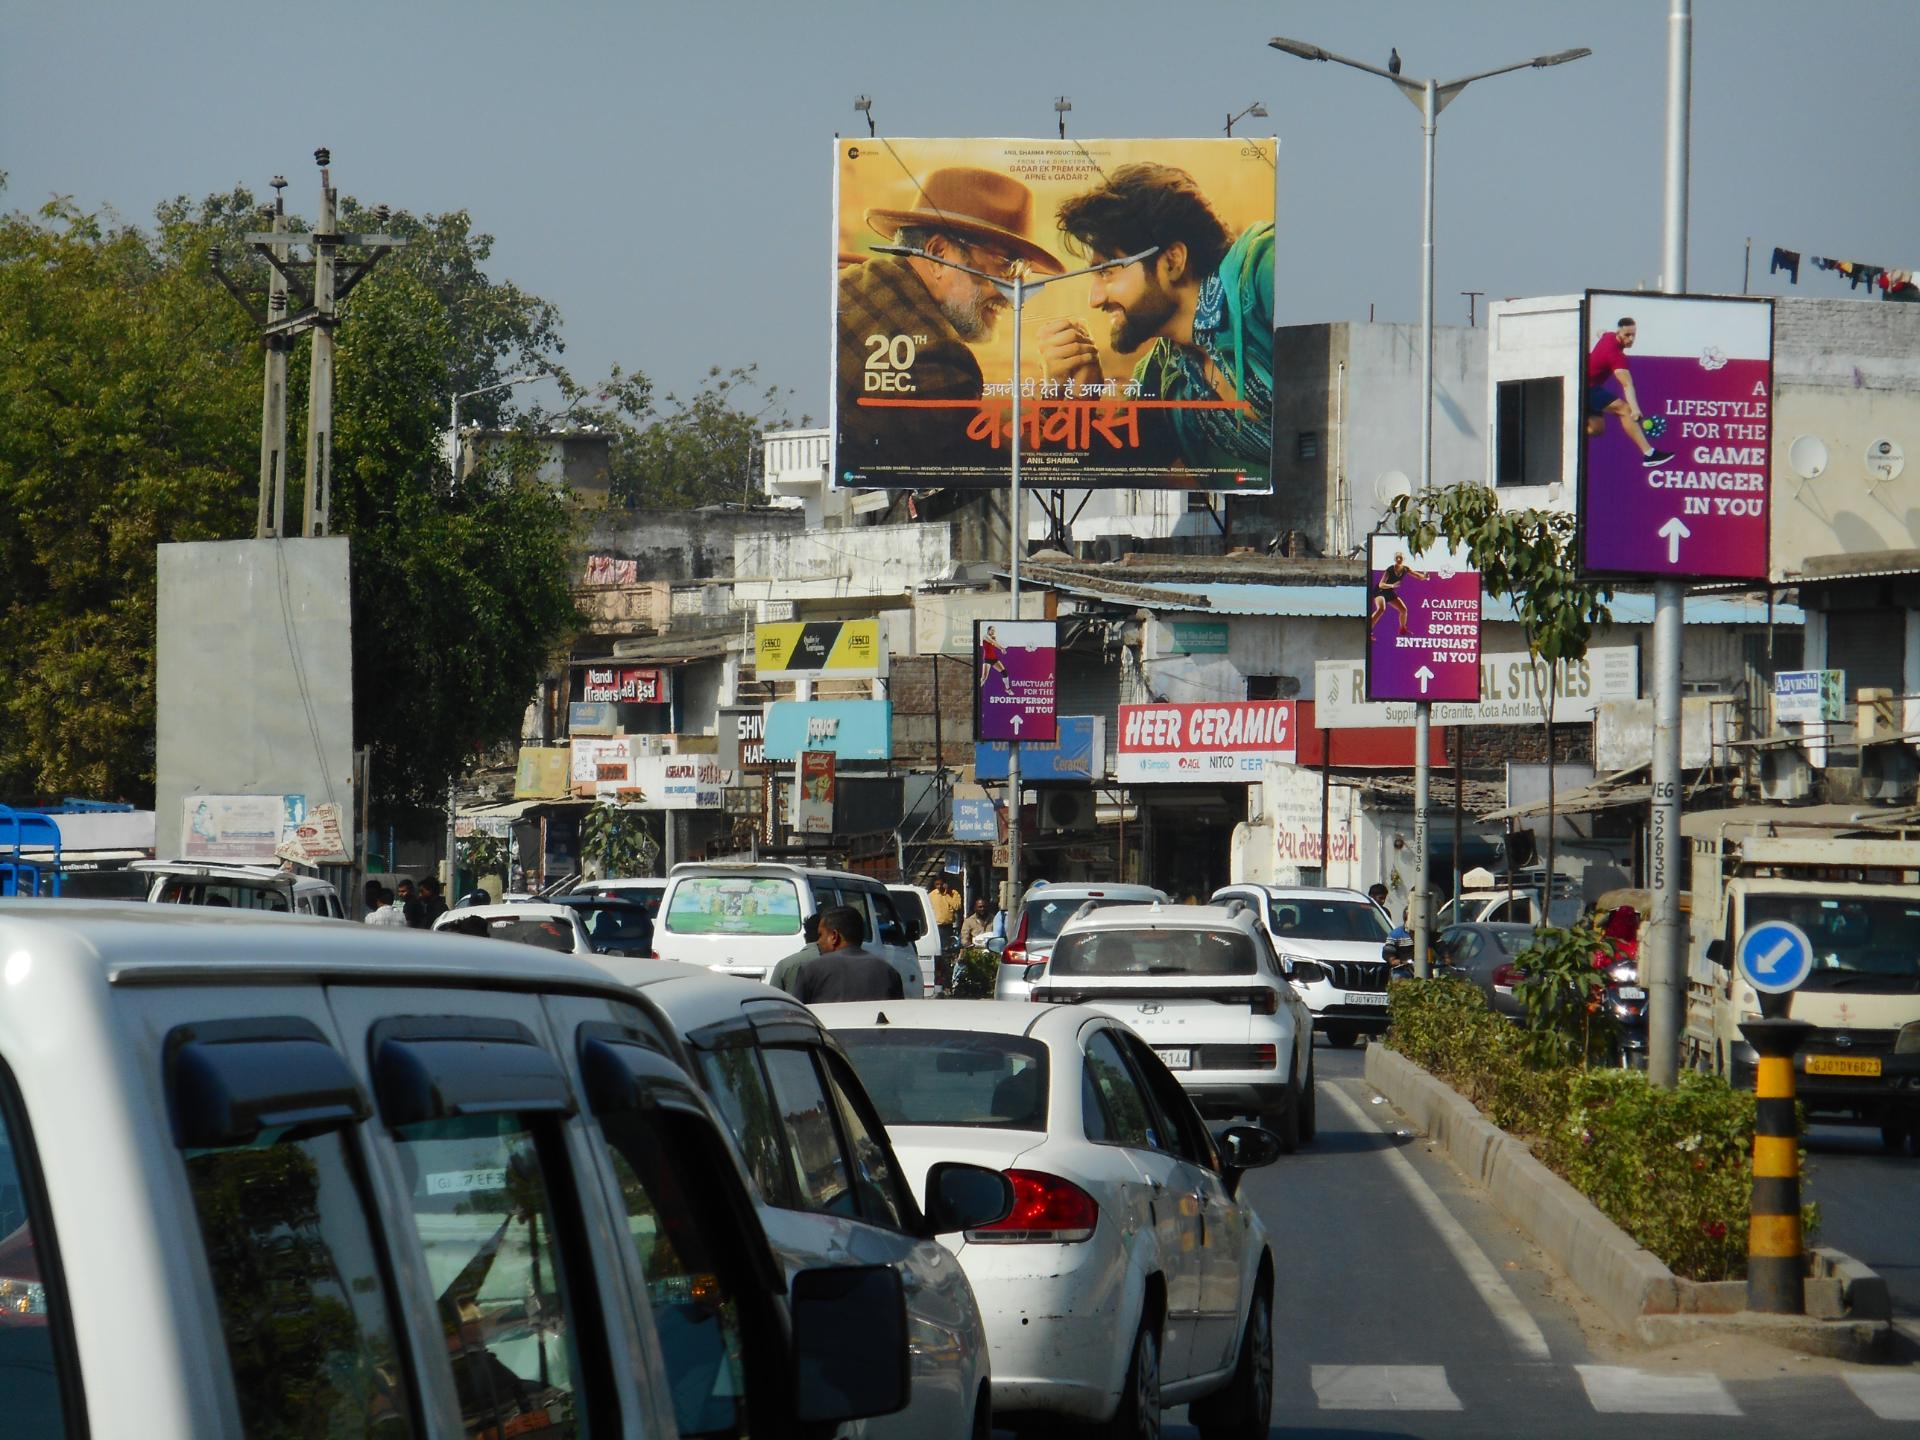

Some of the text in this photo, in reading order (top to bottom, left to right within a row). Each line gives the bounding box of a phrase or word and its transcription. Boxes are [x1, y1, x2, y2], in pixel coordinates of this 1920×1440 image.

[1024, 173, 1047, 181] APNE
[1054, 173, 1082, 181] GADAR
[1083, 173, 1089, 181] 2
[864, 372, 916, 391] DEC.
[1020, 377, 1034, 397] ही
[1040, 378, 1060, 399] देते
[1063, 378, 1076, 399] हैं
[1079, 378, 1116, 397] अपनों
[1751, 381, 1767, 396] A
[1665, 399, 1767, 418] LIFESTYLE
[1682, 422, 1766, 440] FOR THE
[1693, 446, 1766, 466] GAME
[1648, 470, 1764, 491] CHANGER
[1684, 497, 1764, 517] IN YOU
[1421, 598, 1478, 609] A CAMPUS
[1431, 611, 1478, 621] FOR THE
[1428, 624, 1477, 635] SPORTS
[1395, 637, 1477, 649] ENTHUSIAST
[1432, 652, 1476, 663] IN YOU
[589, 669, 613, 684] Nandi
[1011, 680, 1054, 688] SANCTUARY
[1508, 658, 1591, 700] STONES
[1775, 673, 1818, 695] Aayushi
[1038, 688, 1054, 696] THE
[989, 696, 1054, 704] SPORTSPERSON
[1025, 706, 1054, 714] IN YOU
[1430, 705, 1438, 718] of
[1441, 704, 1476, 720] Granite,
[1479, 703, 1499, 717] Kota
[1502, 703, 1520, 717] And
[1125, 706, 1289, 748] HEER CERAMIC
[1187, 759, 1200, 769] AGL
[1209, 756, 1234, 769] NITCO
[1240, 758, 1267, 771] CER
[1655, 810, 1664, 890] 32835
[1157, 1051, 1188, 1066] 5144
